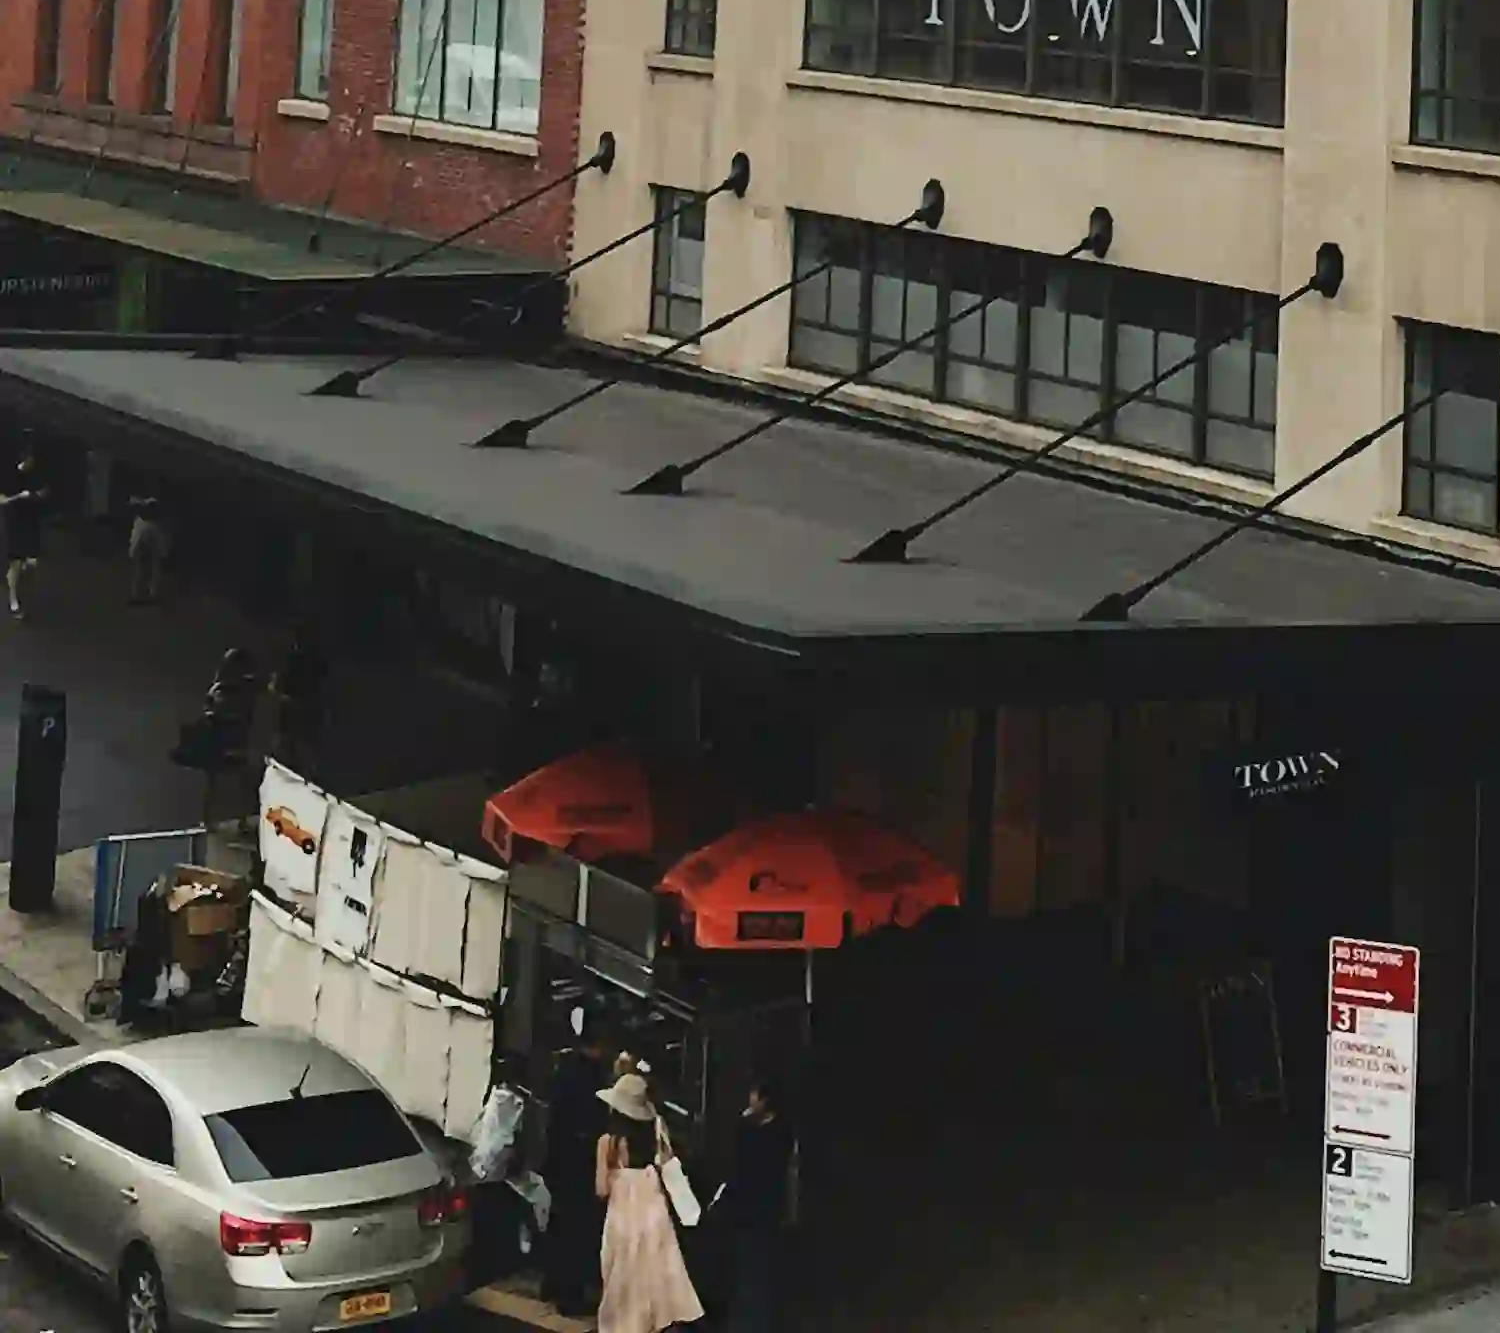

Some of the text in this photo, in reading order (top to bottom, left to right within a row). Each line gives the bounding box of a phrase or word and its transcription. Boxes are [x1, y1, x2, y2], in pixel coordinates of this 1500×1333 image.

[1233, 748, 1341, 788] TOWN
[1352, 948, 1403, 967] STANDING
[1335, 1005, 1351, 1031] 3
[1331, 1147, 1347, 1174] 2
